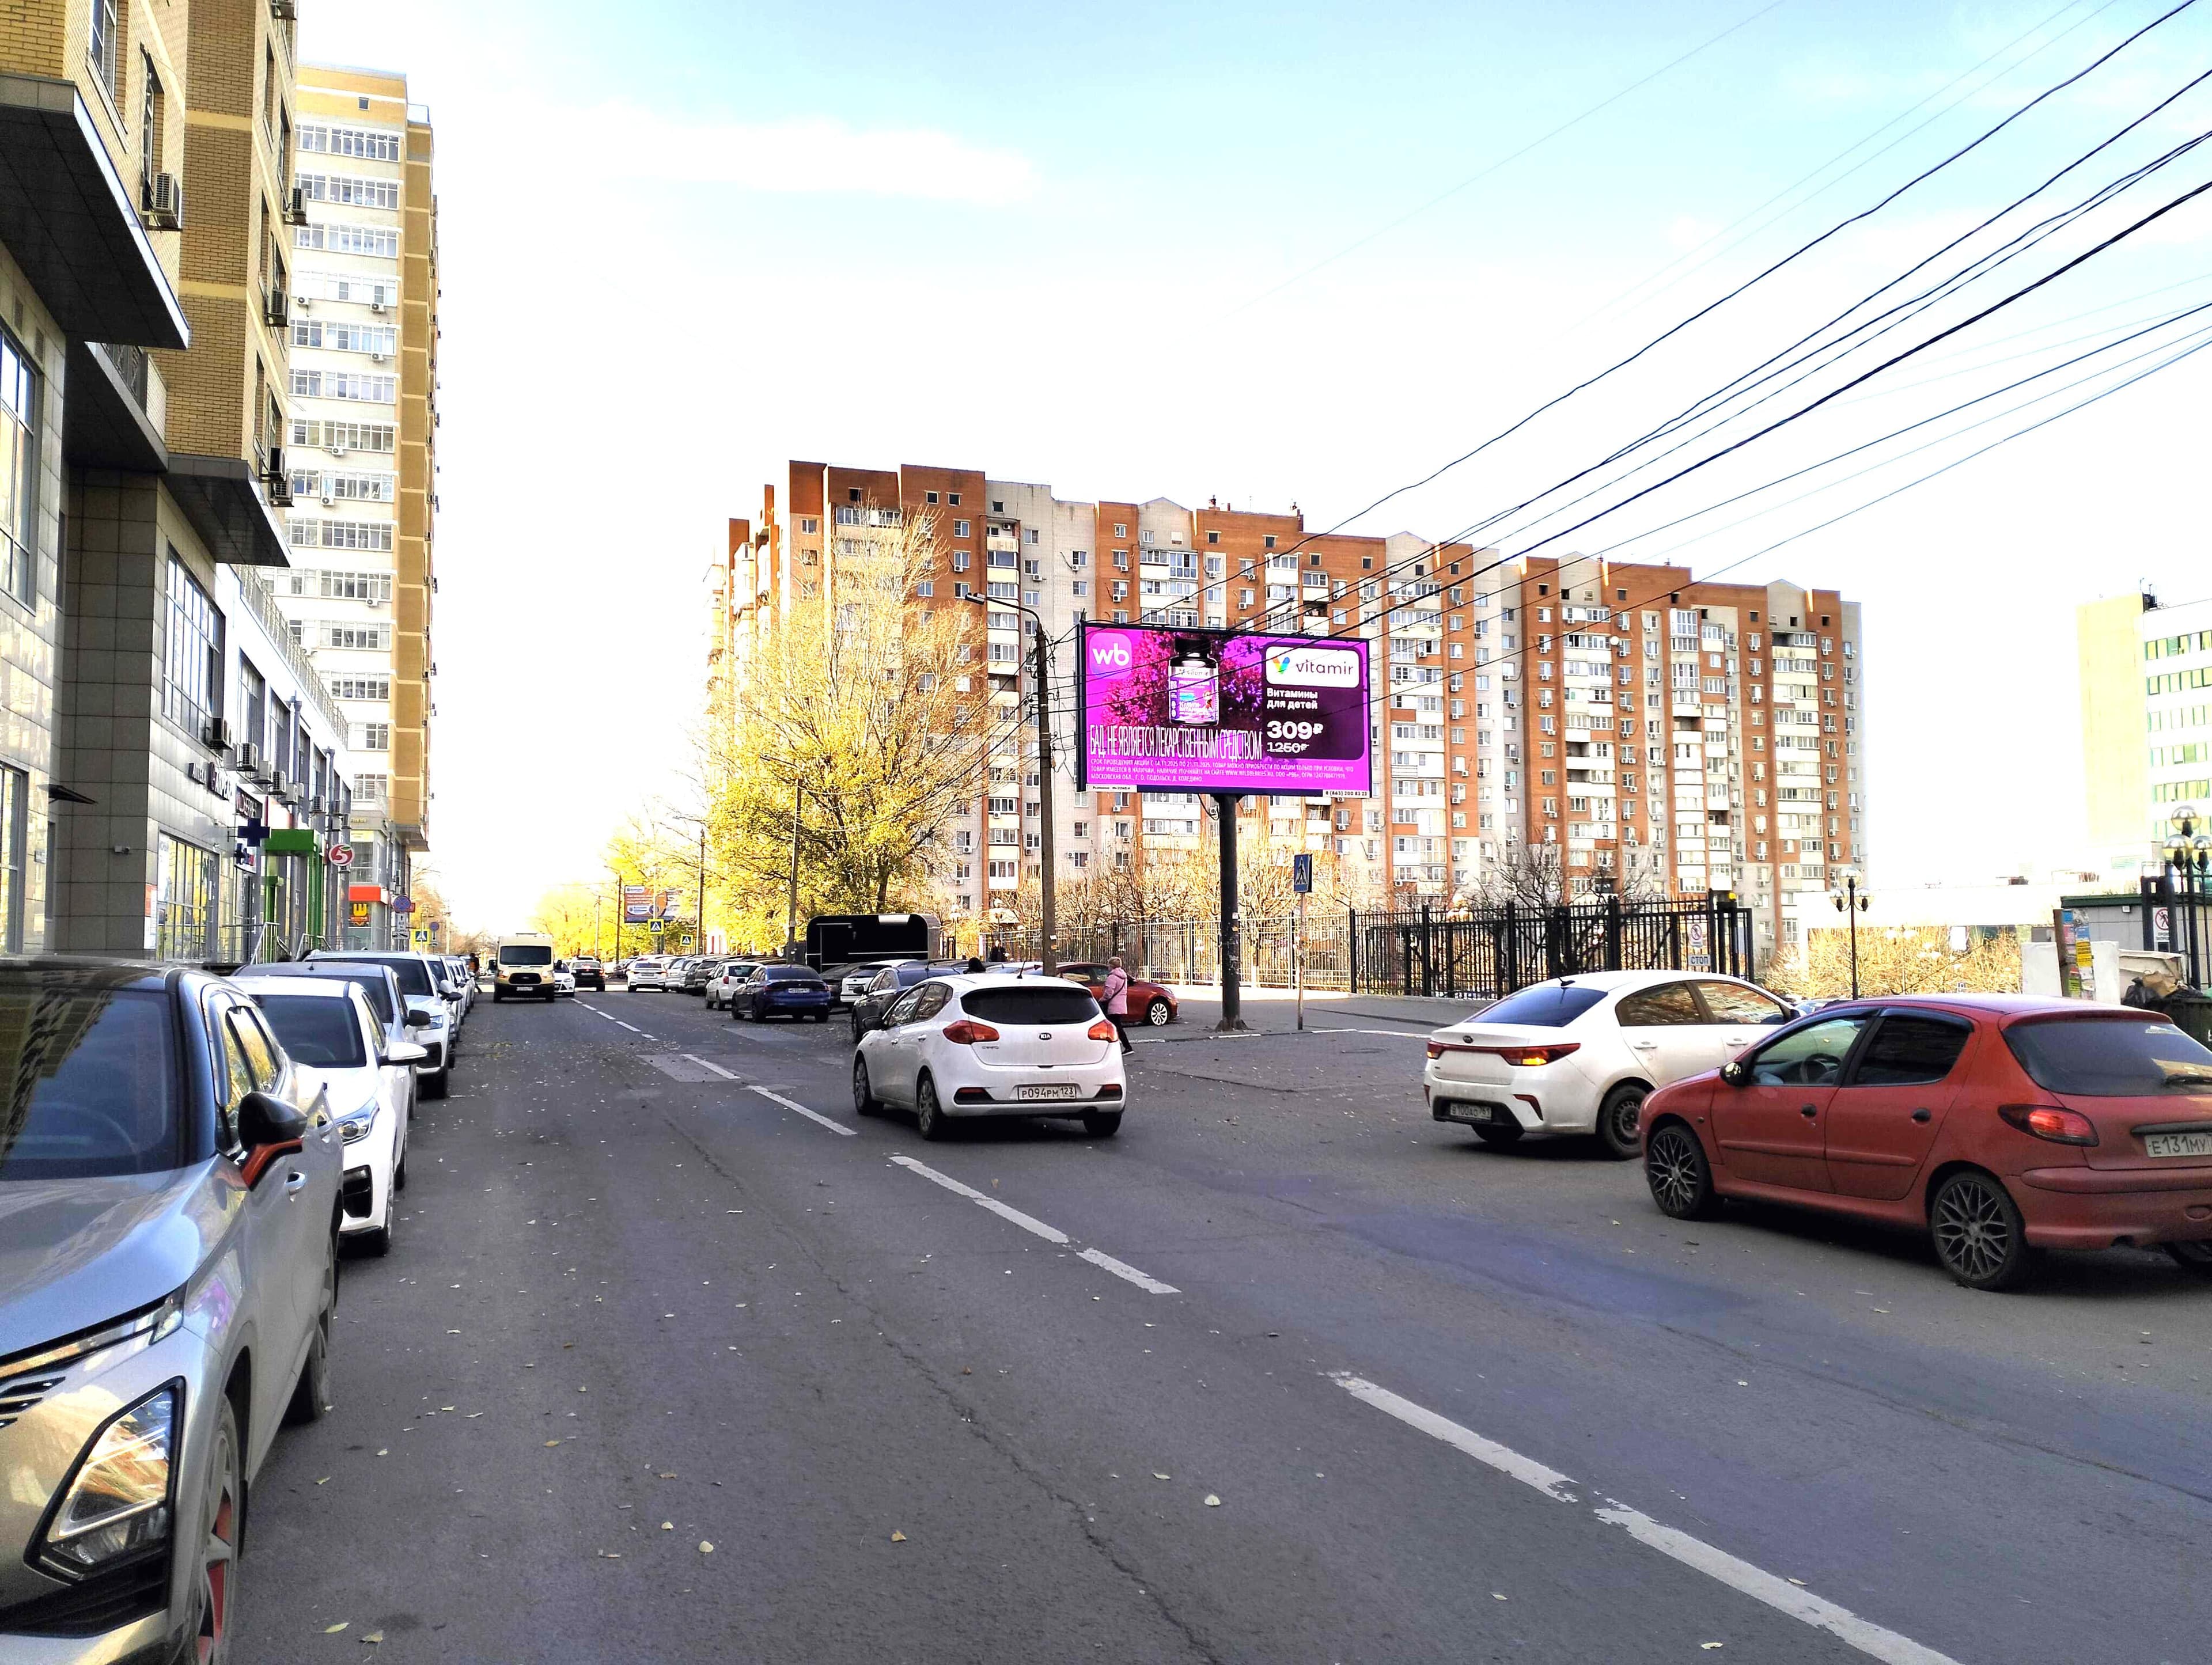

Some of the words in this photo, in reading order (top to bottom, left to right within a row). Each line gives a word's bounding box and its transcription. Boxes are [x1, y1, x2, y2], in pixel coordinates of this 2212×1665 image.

[1093, 643, 1129, 665] wb
[1296, 659, 1354, 674] vitamir
[1267, 688, 1318, 699] Витамины
[1267, 700, 1286, 709] для
[1287, 700, 1318, 710] детей
[1107, 725, 1118, 756] НЕ
[1118, 726, 1154, 756] ЯВЛЯЕТСЯ
[1156, 727, 1218, 759] ЛЕКАРСТВЕННЫМ
[1219, 729, 1262, 763] СРЕДСТВОМ
[334, 849, 348, 864] 5
[1691, 956, 1709, 964] СТОП
[1022, 1088, 1059, 1098] Р094РМ
[2152, 1135, 2206, 1154] Е131МУ
